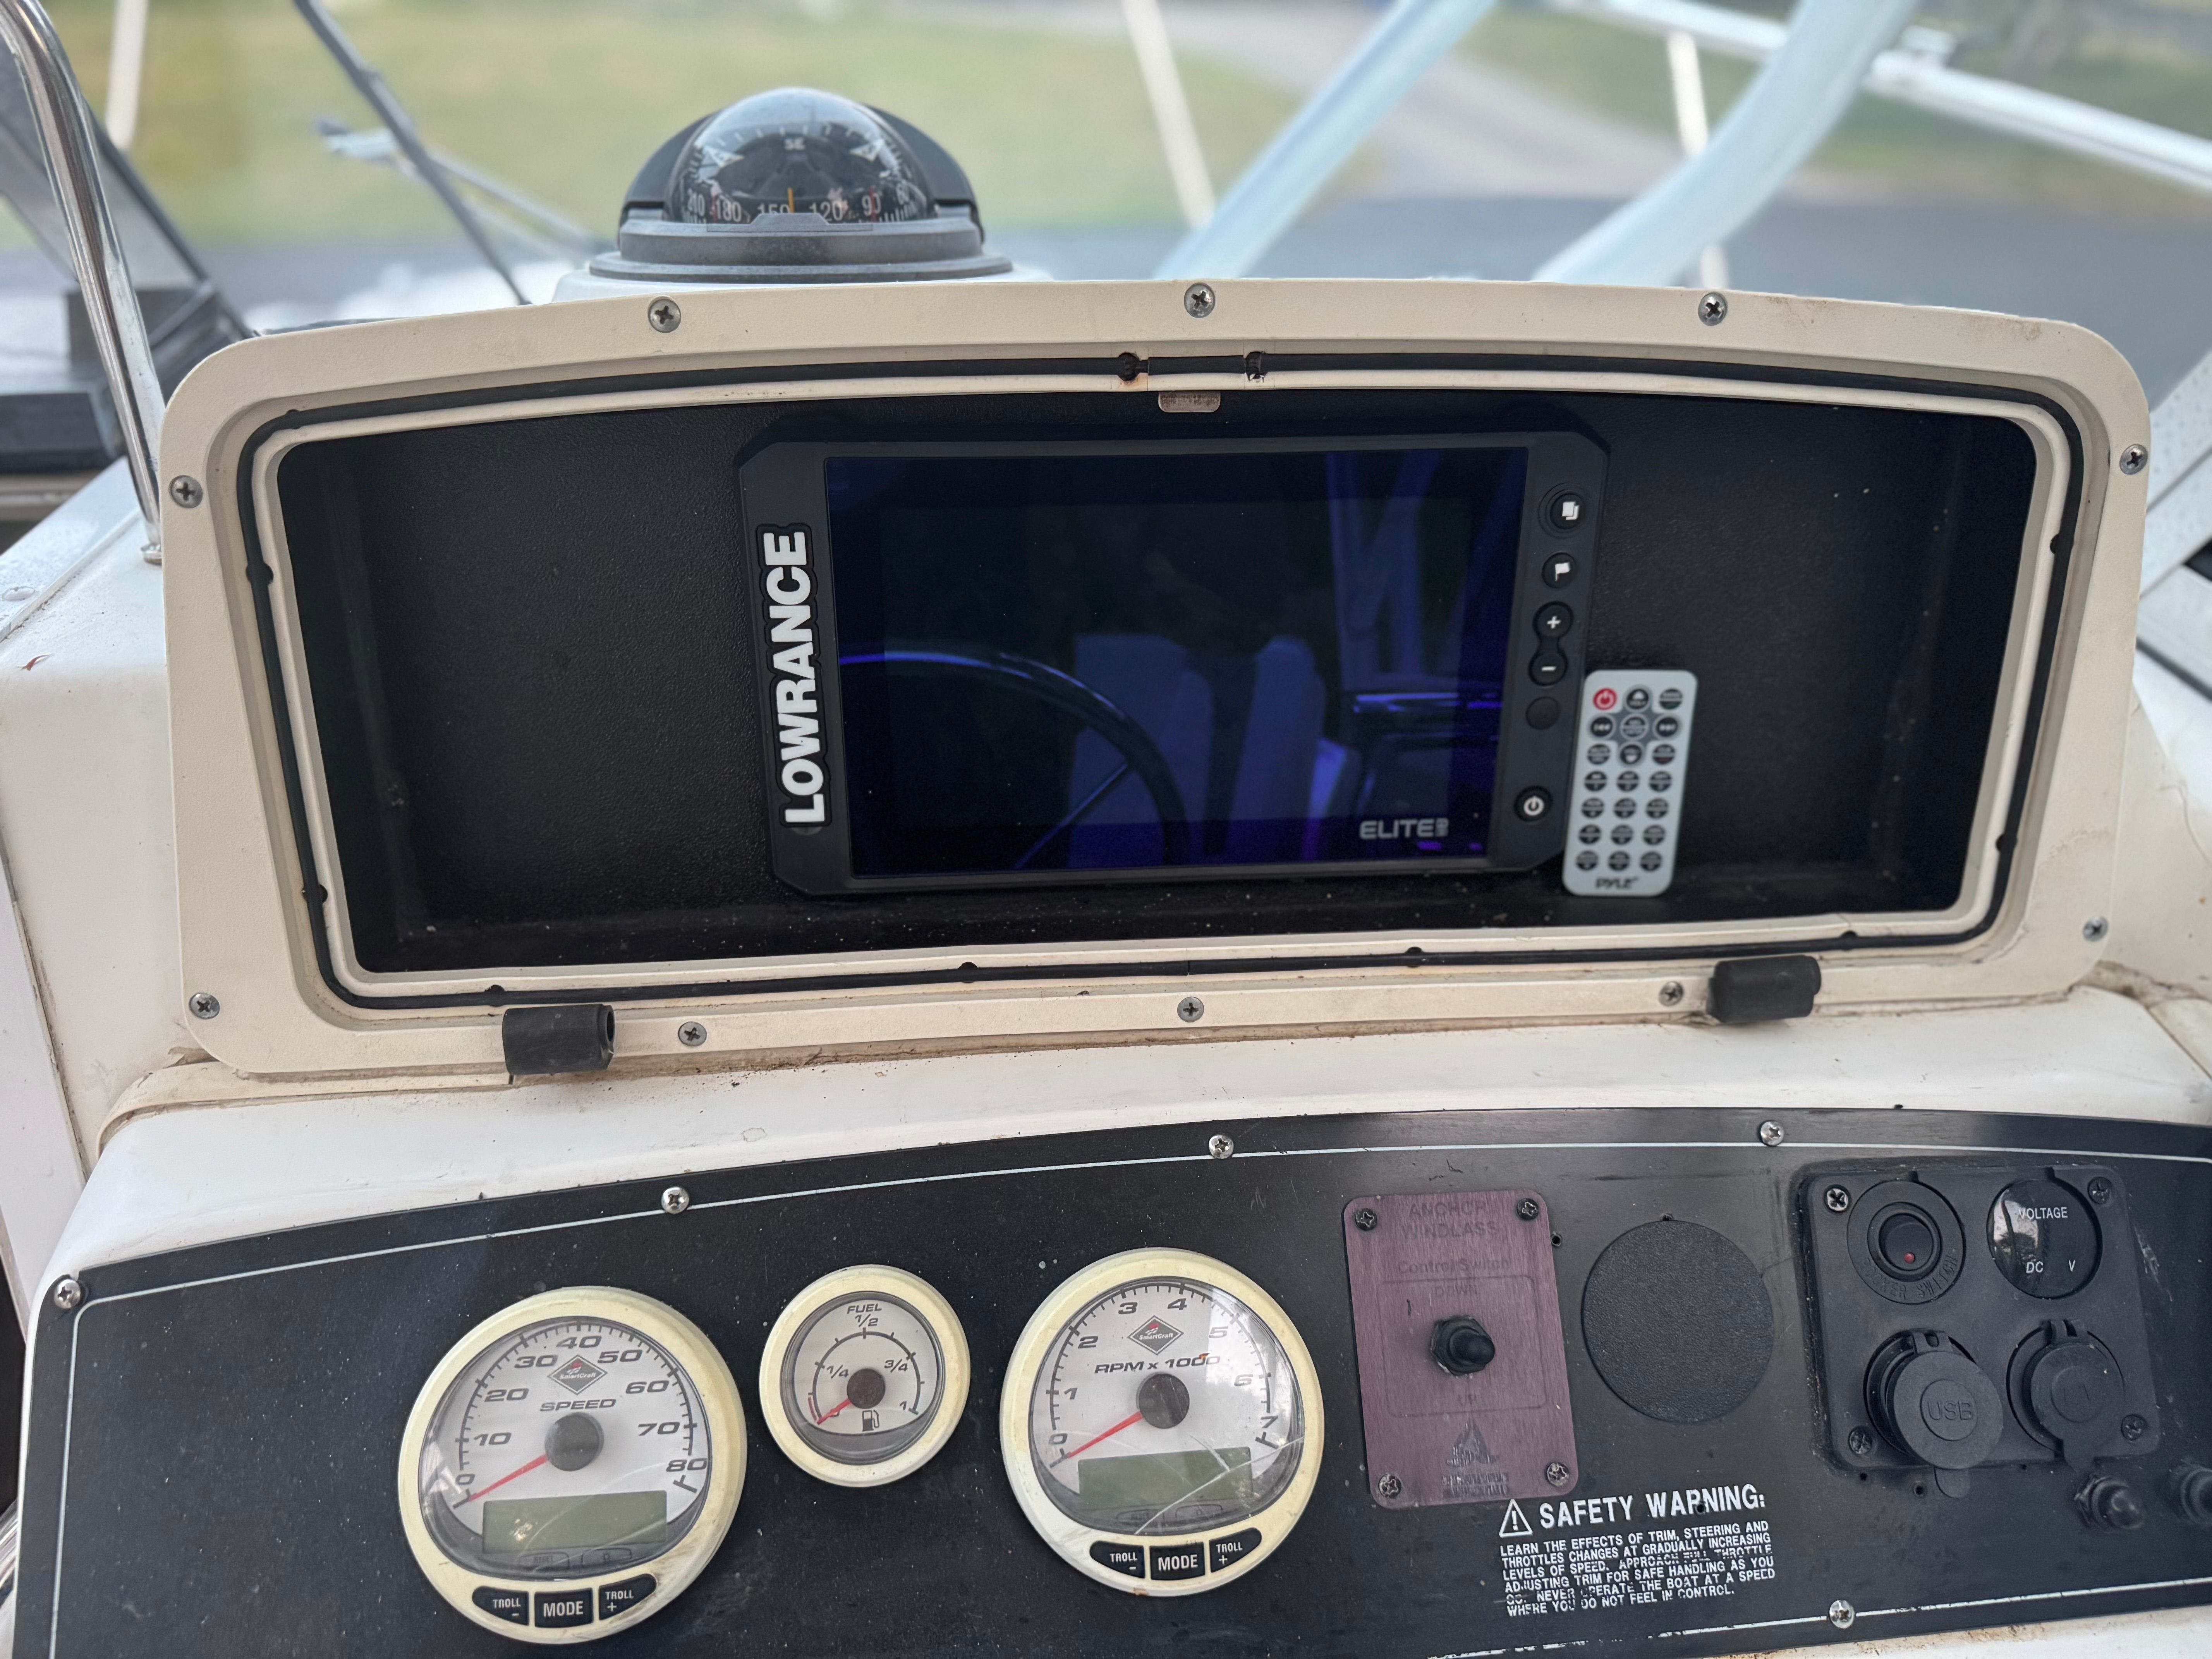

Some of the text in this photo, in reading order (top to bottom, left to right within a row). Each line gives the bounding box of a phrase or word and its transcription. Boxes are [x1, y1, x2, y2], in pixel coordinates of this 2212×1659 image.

[716, 194, 742, 223] 180
[809, 201, 843, 222] 120
[862, 193, 882, 216] 90
[763, 532, 826, 823] LOWRANCE
[1359, 818, 1435, 840] ELITE
[1409, 1200, 1487, 1217] ANCHOR
[2018, 1207, 2068, 1220] VOLTAGE
[1401, 1221, 1498, 1240] WINDLASS
[1398, 1258, 1510, 1274] Control Switch
[2025, 1260, 2076, 1274] DC V
[1860, 1254, 1959, 1300] ROCKER SWITCH
[847, 1303, 883, 1314] FUEL
[1118, 1302, 1138, 1315] 3
[1167, 1298, 1188, 1311] 4
[854, 1314, 879, 1328] 1/2
[1139, 1332, 1174, 1341] SmartCraft
[1209, 1326, 1228, 1339] 5
[556, 1335, 602, 1350] 40
[1077, 1335, 1099, 1349] 2
[514, 1354, 558, 1369] 30
[597, 1349, 644, 1364] 50
[827, 1364, 850, 1379] 1/4
[884, 1359, 909, 1373] 3/4
[1094, 1361, 1145, 1374] RPM
[1164, 1355, 1221, 1368] 1000
[625, 1379, 669, 1394] 60
[1234, 1374, 1253, 1387] 6
[484, 1388, 529, 1403] 20
[1063, 1387, 1078, 1400] 1
[539, 1398, 617, 1412] SPEED
[1925, 1399, 1975, 1421] USB
[637, 1422, 680, 1436] 70
[473, 1432, 512, 1446] 10
[1048, 1432, 1068, 1445] 0
[665, 1458, 708, 1472] 80
[455, 1473, 475, 1486] 0
[1539, 1484, 1766, 1529] SAFETY WARNING:
[1500, 1520, 1769, 1557] LEARN THE EFFECTS OF TRIM, STEERING AND
[1216, 1542, 1243, 1553] TROLL
[1501, 1532, 1771, 1569] THROTTLES CHANGES AT GRADUALLY INCREASING
[1109, 1551, 1138, 1563] TROLL
[1158, 1554, 1198, 1570] MODE
[1503, 1566, 1545, 1581] LEVELS
[1550, 1564, 1565, 1577] OF
[1574, 1573, 1602, 1586] TRIM
[1606, 1570, 1630, 1583] FOR
[1634, 1566, 1665, 1580] SAFE
[1668, 1561, 1726, 1577] HANDLING
[1730, 1559, 1746, 1571] AS
[1750, 1556, 1774, 1569] YOU
[1536, 1588, 1576, 1602] NEVER
[1639, 1579, 1662, 1592] THE
[1666, 1575, 1699, 1589] BOAT
[1704, 1573, 1720, 1585] AT
[1725, 1571, 1735, 1584] A
[1738, 1568, 1776, 1582] SPEED
[605, 1589, 634, 1600] TROLL
[493, 1597, 522, 1609] TROLL
[543, 1600, 584, 1617] MODE
[1506, 1602, 1548, 1617] WHERE
[1552, 1599, 1576, 1613] YOU
[1580, 1597, 1597, 1609] DO
[1601, 1594, 1625, 1607] NOT
[1630, 1591, 1658, 1604] FEEL
[1661, 1589, 1673, 1602] IN
